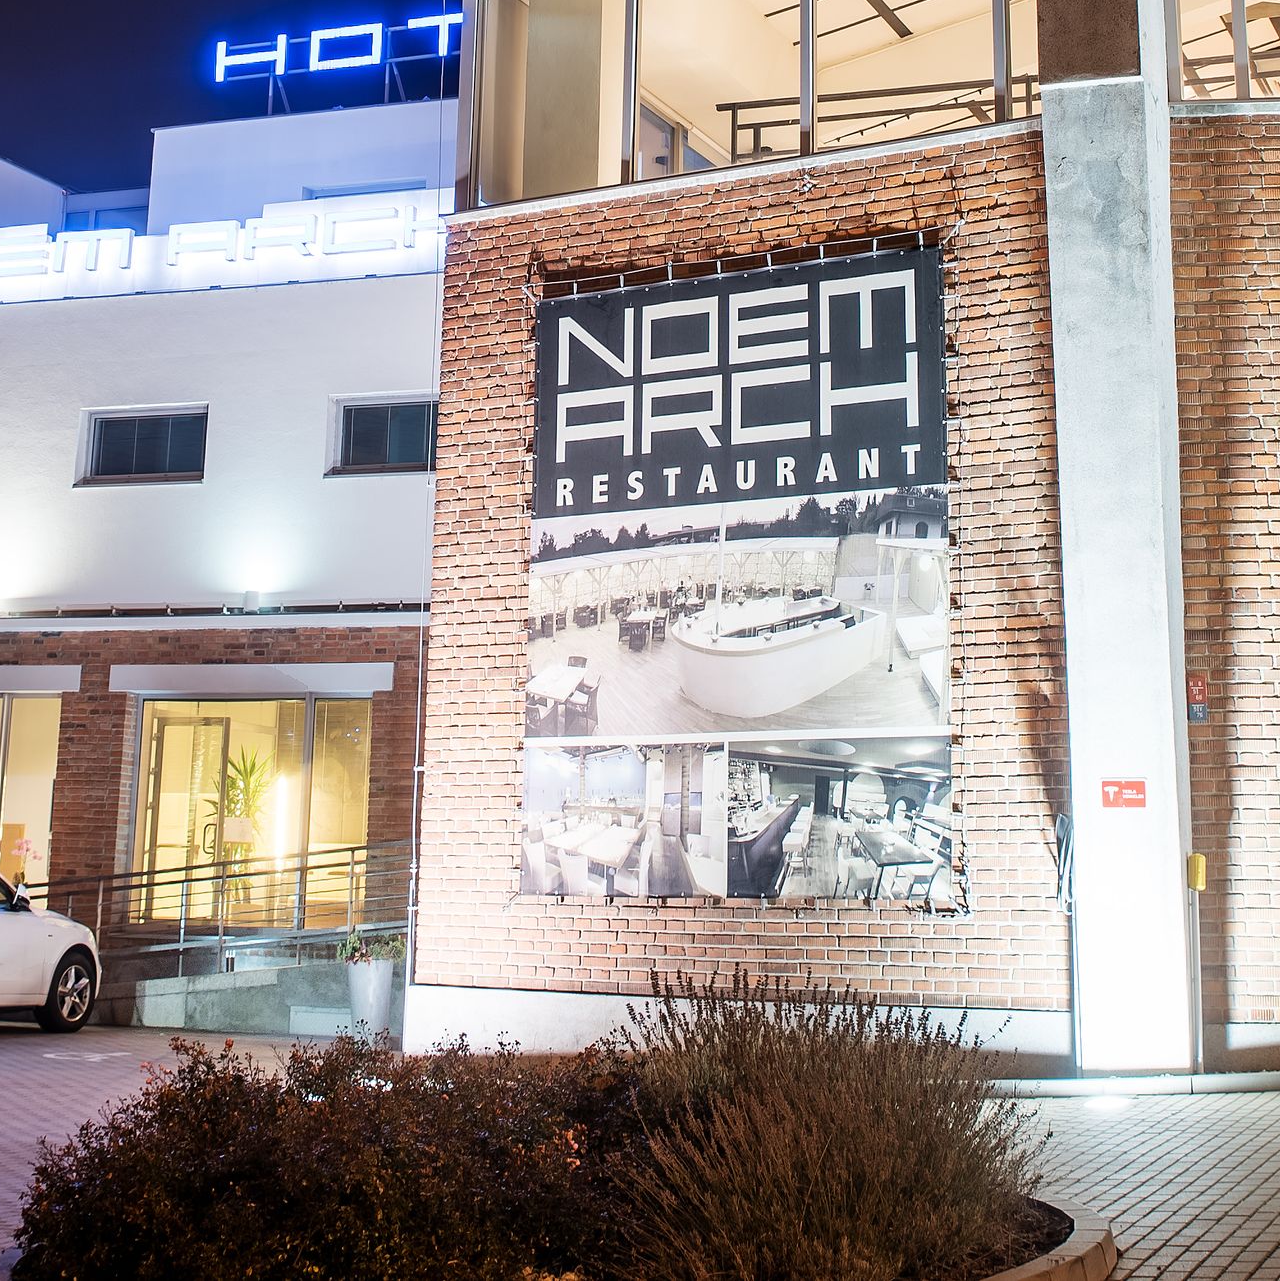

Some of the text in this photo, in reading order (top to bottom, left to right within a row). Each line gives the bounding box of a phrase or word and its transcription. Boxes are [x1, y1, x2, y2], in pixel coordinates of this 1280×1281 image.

[557, 268, 916, 386] NOEM
[556, 351, 920, 463] ARCH
[555, 443, 921, 506] RESTAURANT
